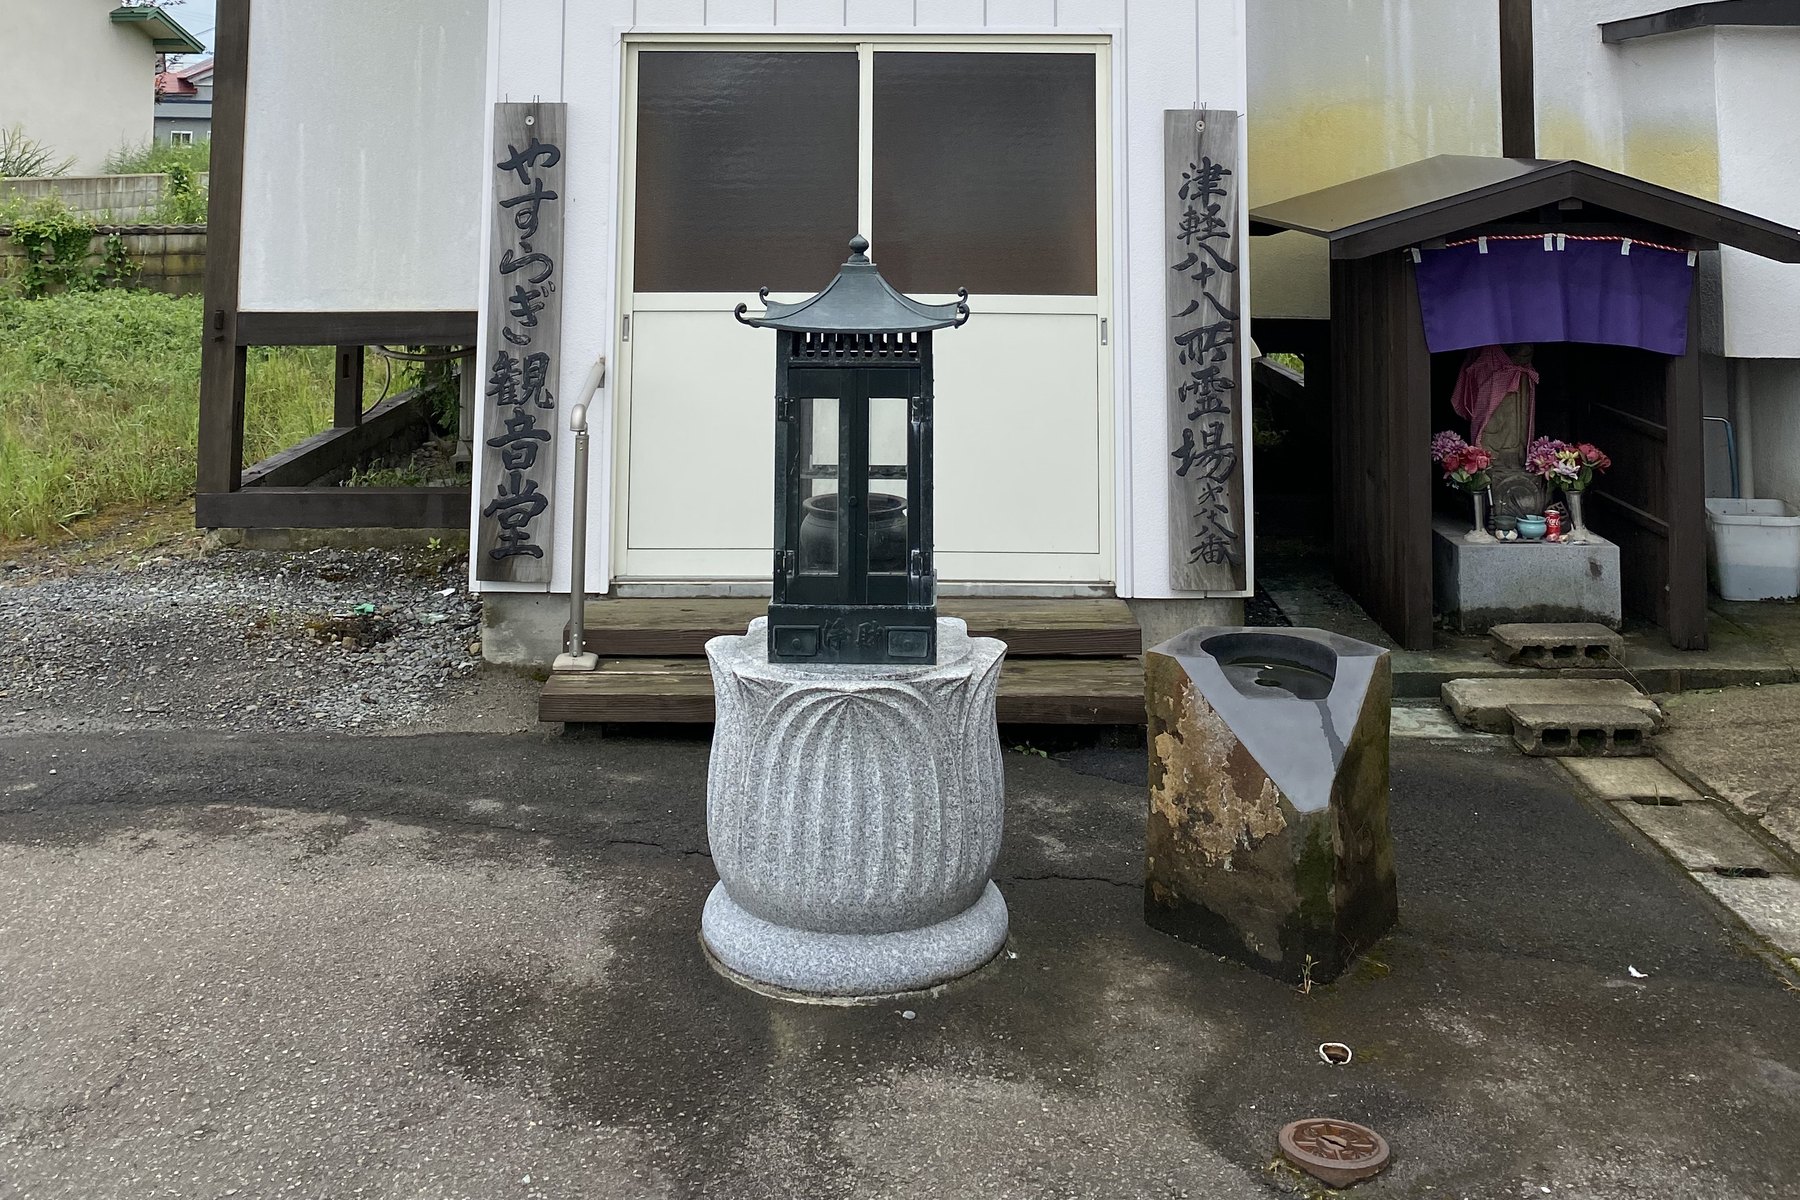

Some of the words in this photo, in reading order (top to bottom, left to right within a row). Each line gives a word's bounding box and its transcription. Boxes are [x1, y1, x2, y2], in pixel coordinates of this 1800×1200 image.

[483, 137, 561, 561] やすらぎ観音堂
